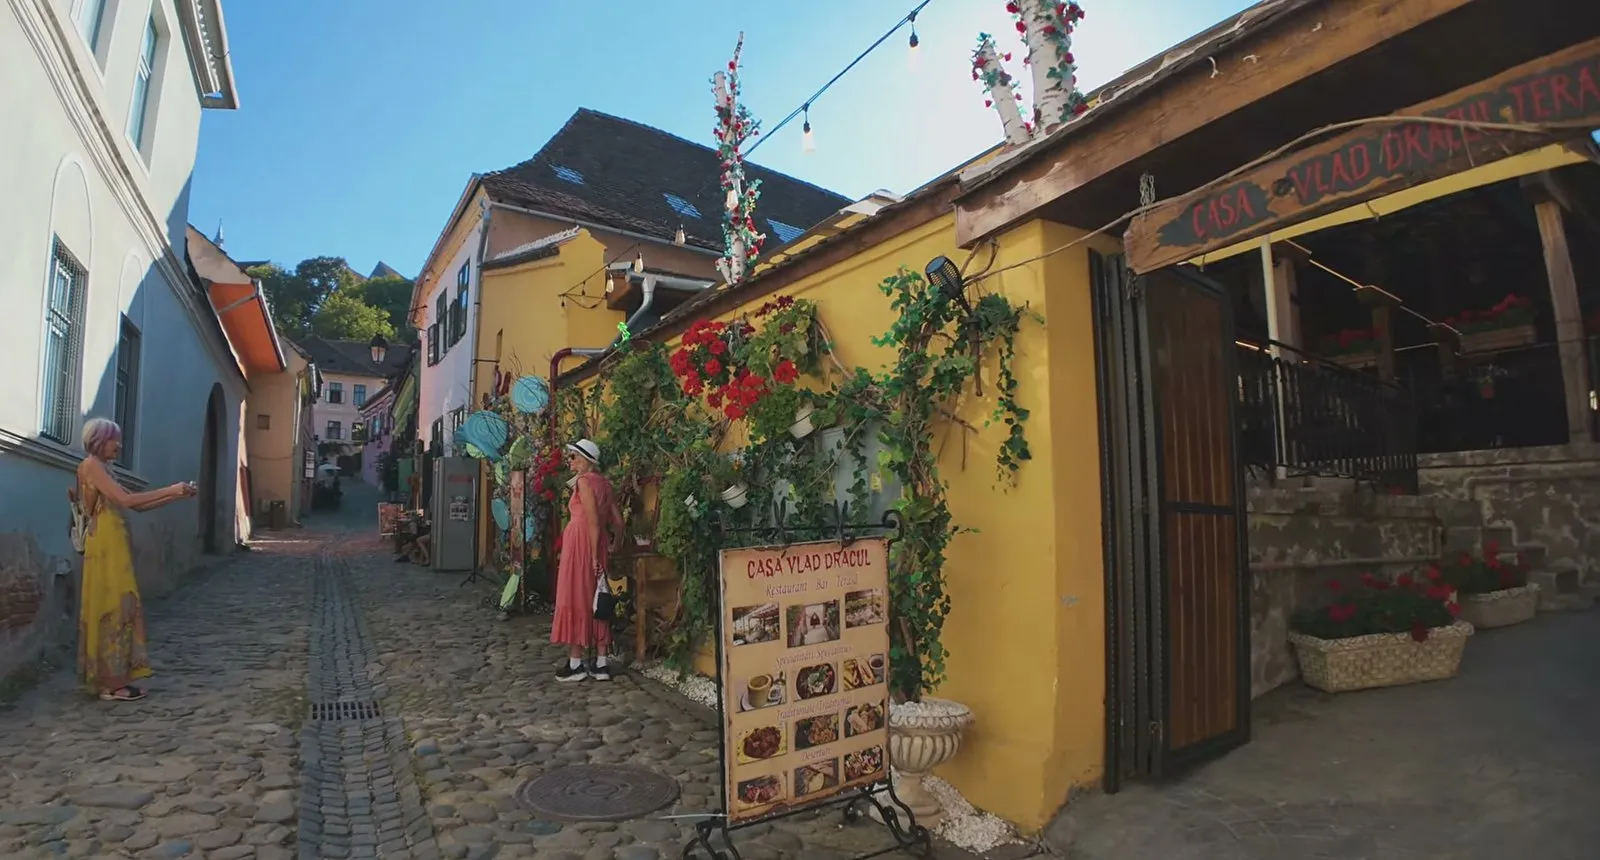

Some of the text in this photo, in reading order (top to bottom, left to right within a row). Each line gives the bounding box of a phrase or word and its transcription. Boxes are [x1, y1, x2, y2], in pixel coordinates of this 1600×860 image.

[1192, 66, 1600, 241] CASA VLAD DRACUL TERA
[747, 548, 872, 579] CASA VLAD DRACUL
[766, 581, 809, 598] Restaurant
[815, 578, 829, 591] Bar
